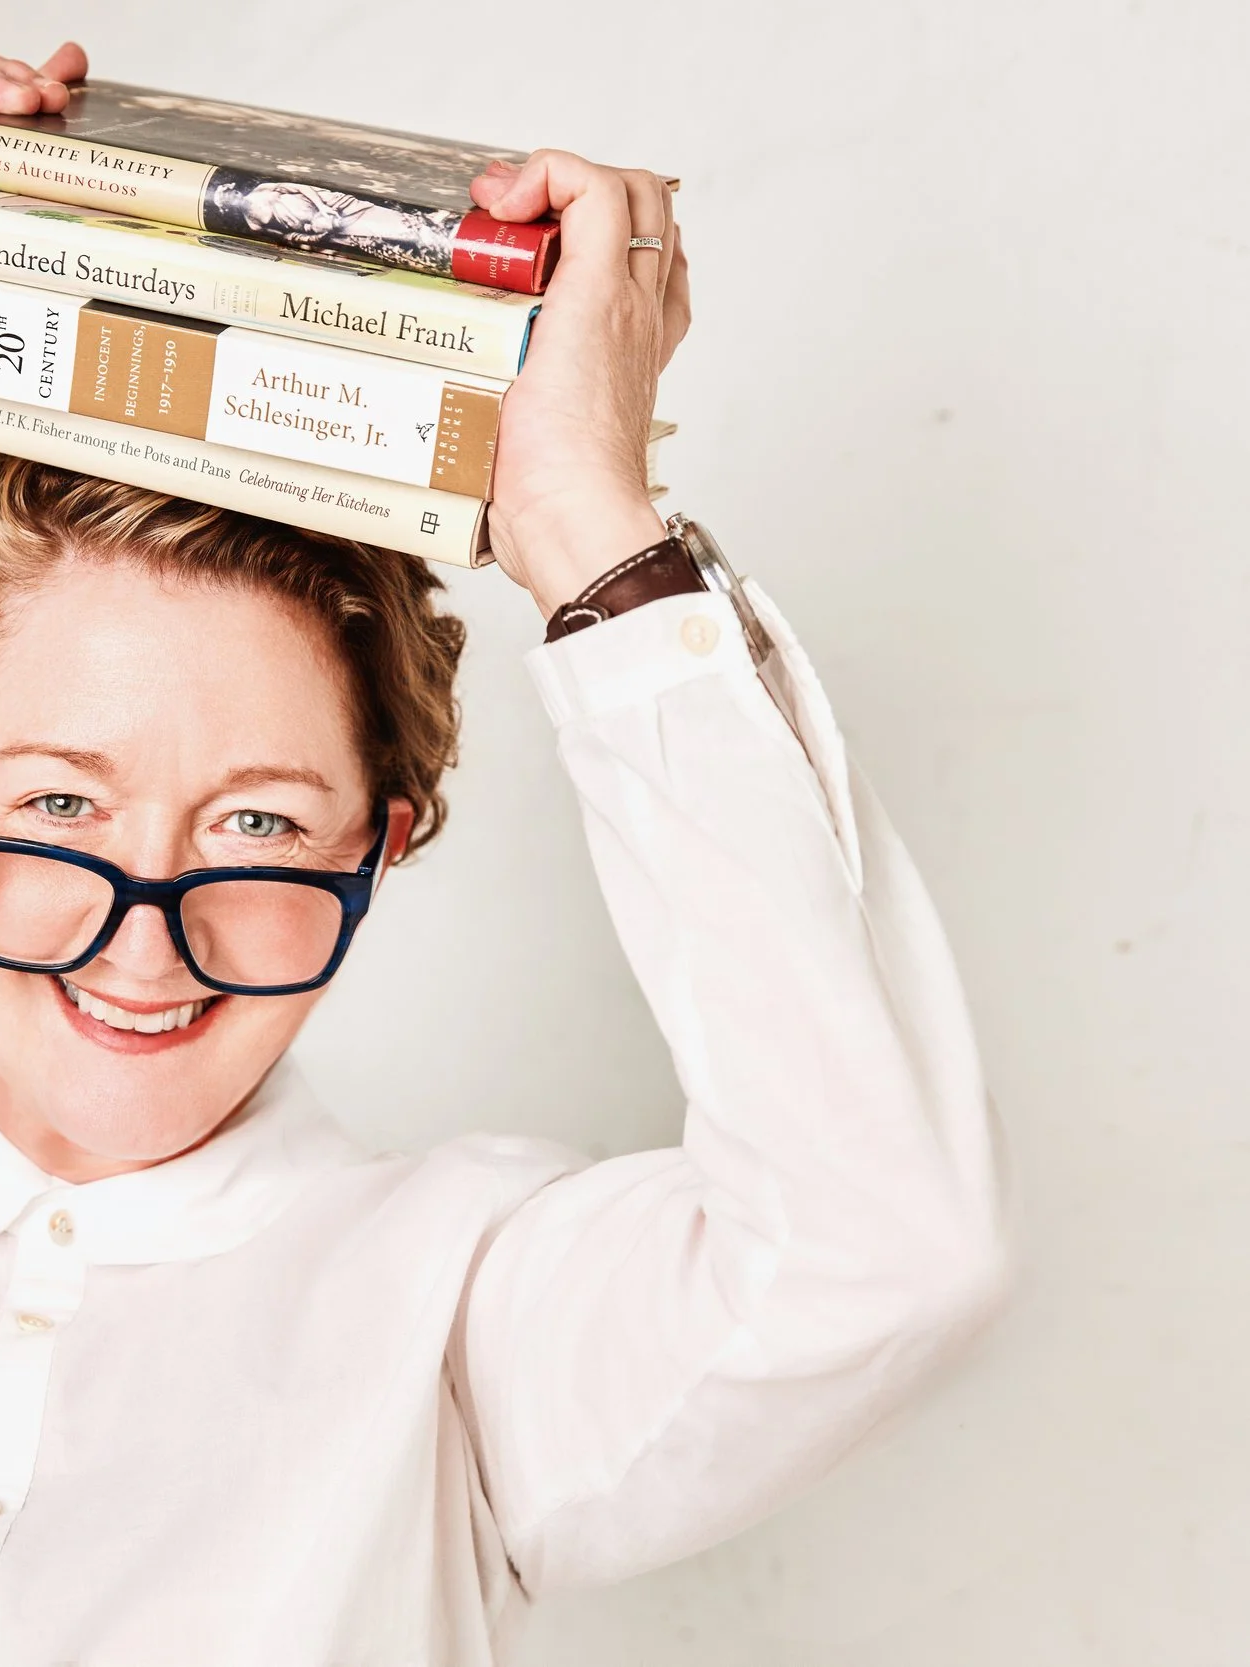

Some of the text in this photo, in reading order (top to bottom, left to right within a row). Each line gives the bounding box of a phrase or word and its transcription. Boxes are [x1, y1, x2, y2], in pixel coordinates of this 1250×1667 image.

[17, 160, 137, 198] AUCHINCLOSS
[89, 149, 175, 180] VARIETY
[75, 254, 196, 305] Saturdays
[279, 291, 477, 354] Michael Frank
[38, 307, 60, 399] CENTURY
[94, 326, 112, 402] INNOCENT
[124, 324, 147, 418] BEGINNINGS,
[251, 367, 367, 409] Arthur M.
[223, 395, 388, 448] Schlesinger, Jr.
[436, 393, 454, 475] MARINER
[447, 407, 463, 464] BOOKS
[32, 417, 72, 441] Fisher
[72, 432, 118, 456] among
[120, 440, 141, 458] the
[144, 445, 171, 466] Pots
[171, 455, 198, 472] and
[199, 458, 232, 480] Pans
[238, 468, 310, 502] Celebrating
[310, 485, 335, 503] Her
[335, 491, 392, 519] Kitchens
